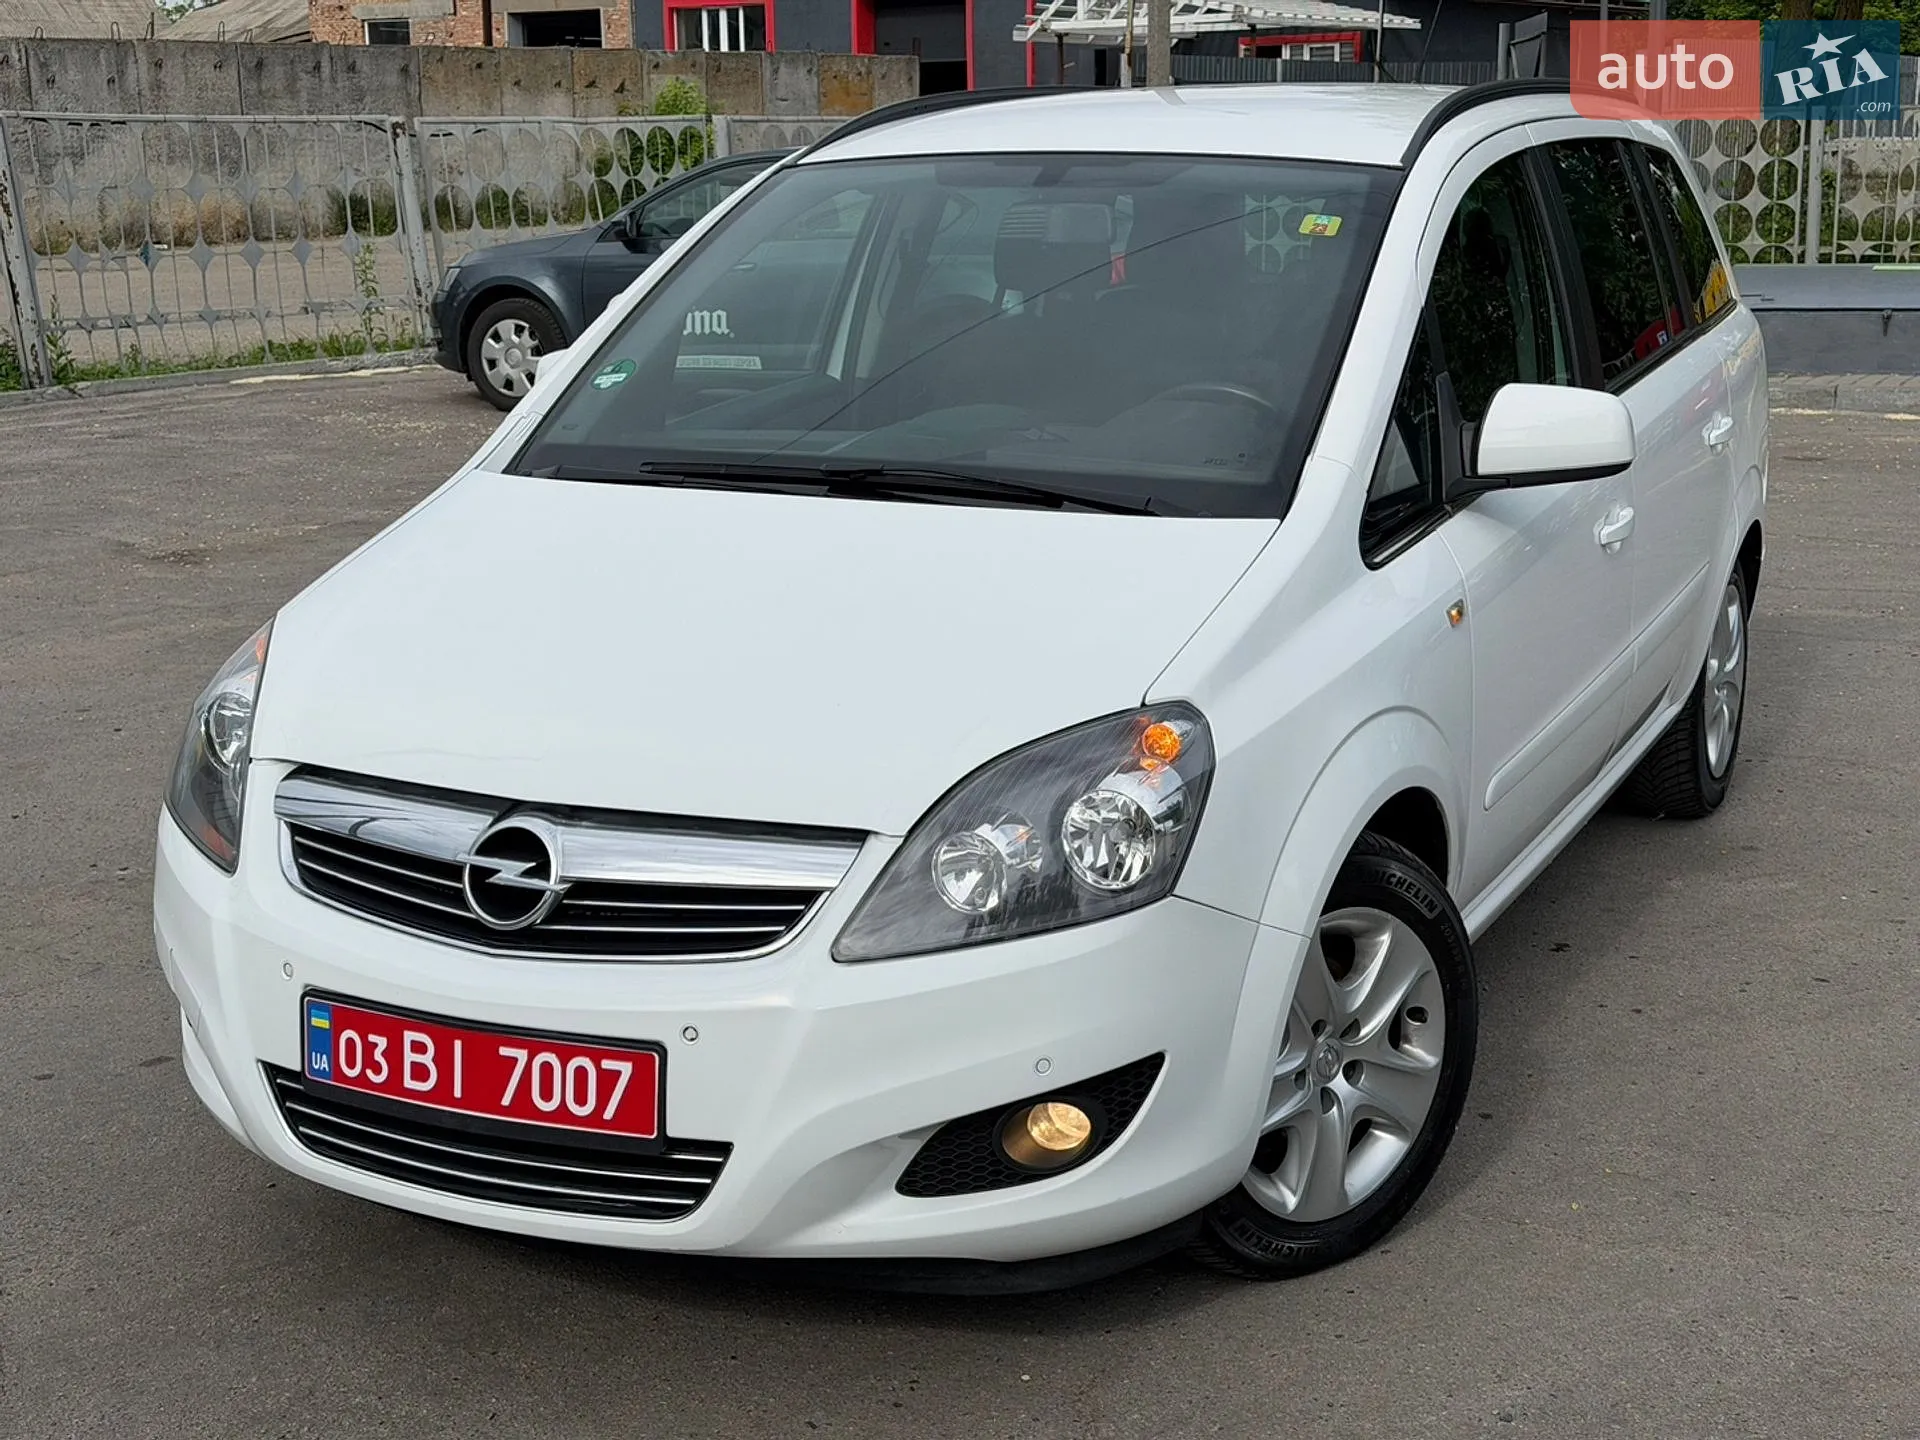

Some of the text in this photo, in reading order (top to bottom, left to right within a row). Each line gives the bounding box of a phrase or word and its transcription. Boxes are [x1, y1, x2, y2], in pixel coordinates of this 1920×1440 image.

[312, 1052, 330, 1073] UA
[338, 1029, 633, 1121] 03 BI 7007
